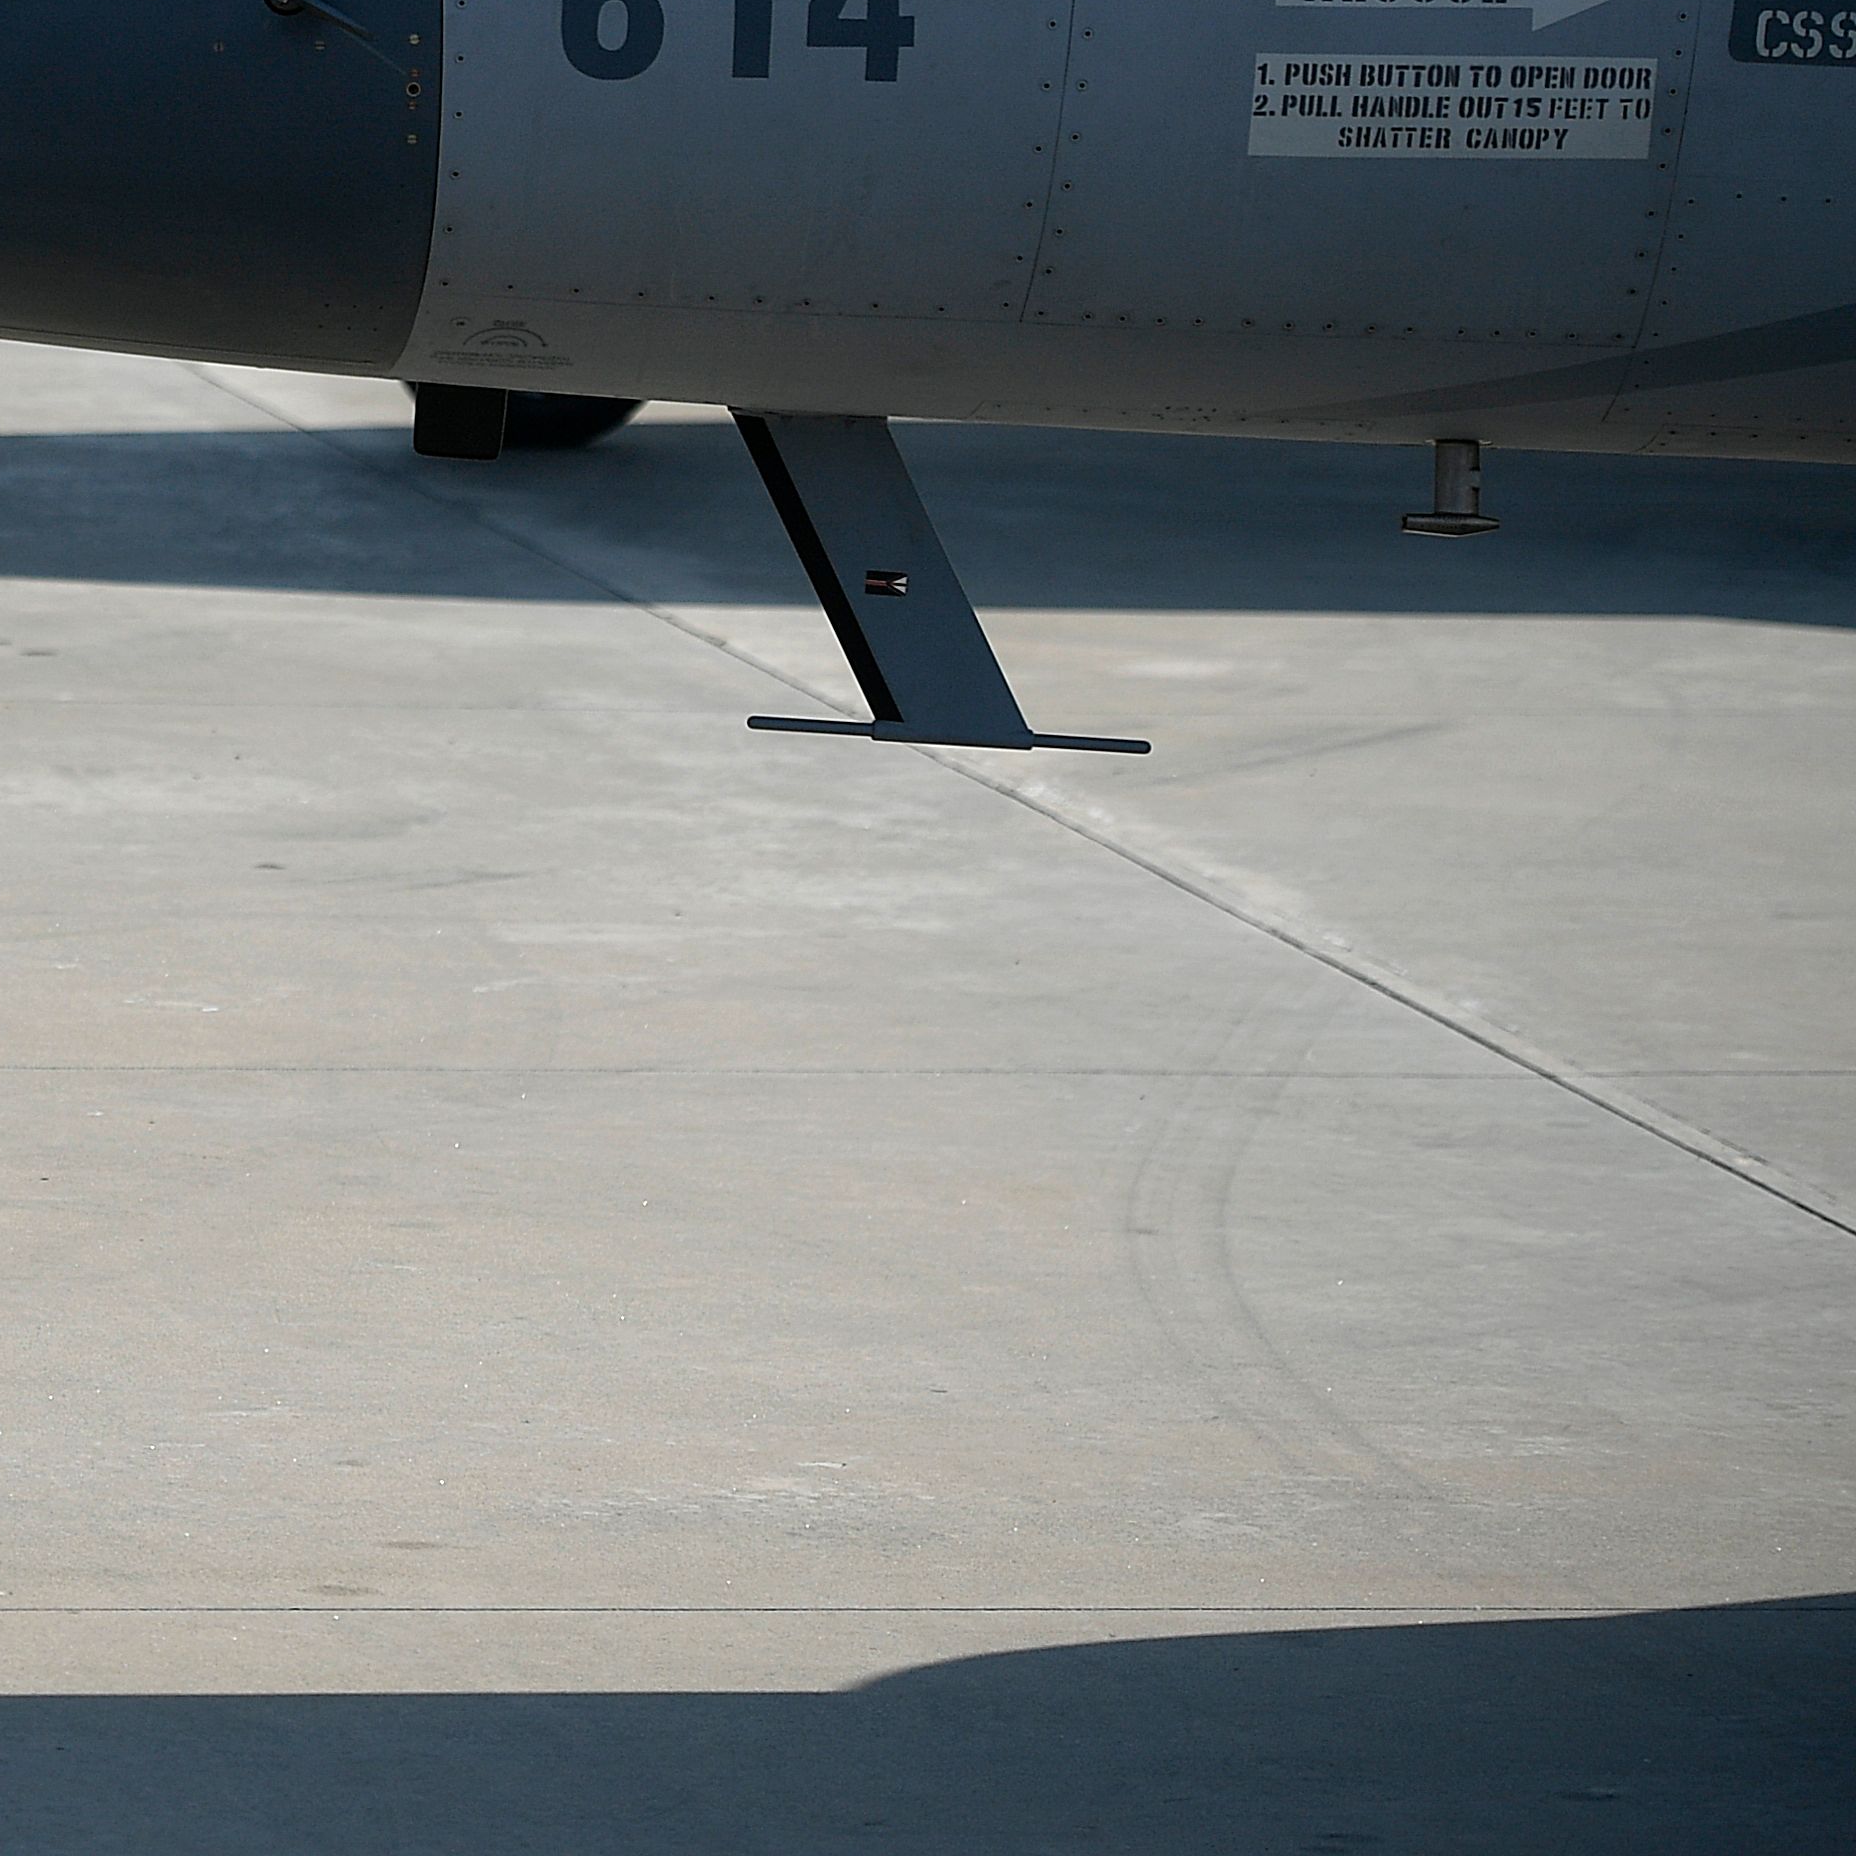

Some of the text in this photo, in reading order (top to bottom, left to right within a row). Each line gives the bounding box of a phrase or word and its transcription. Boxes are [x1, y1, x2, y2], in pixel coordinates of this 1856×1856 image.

[1755, 9, 1856, 59] CSS
[1257, 62, 1653, 90] 1. PUSH BUTTON TO OPEN DOOR
[1252, 94, 1652, 121] 2. PULL HANDLE OUT 15 FEET TO
[1337, 126, 1569, 150] SHATTER CANOPY
